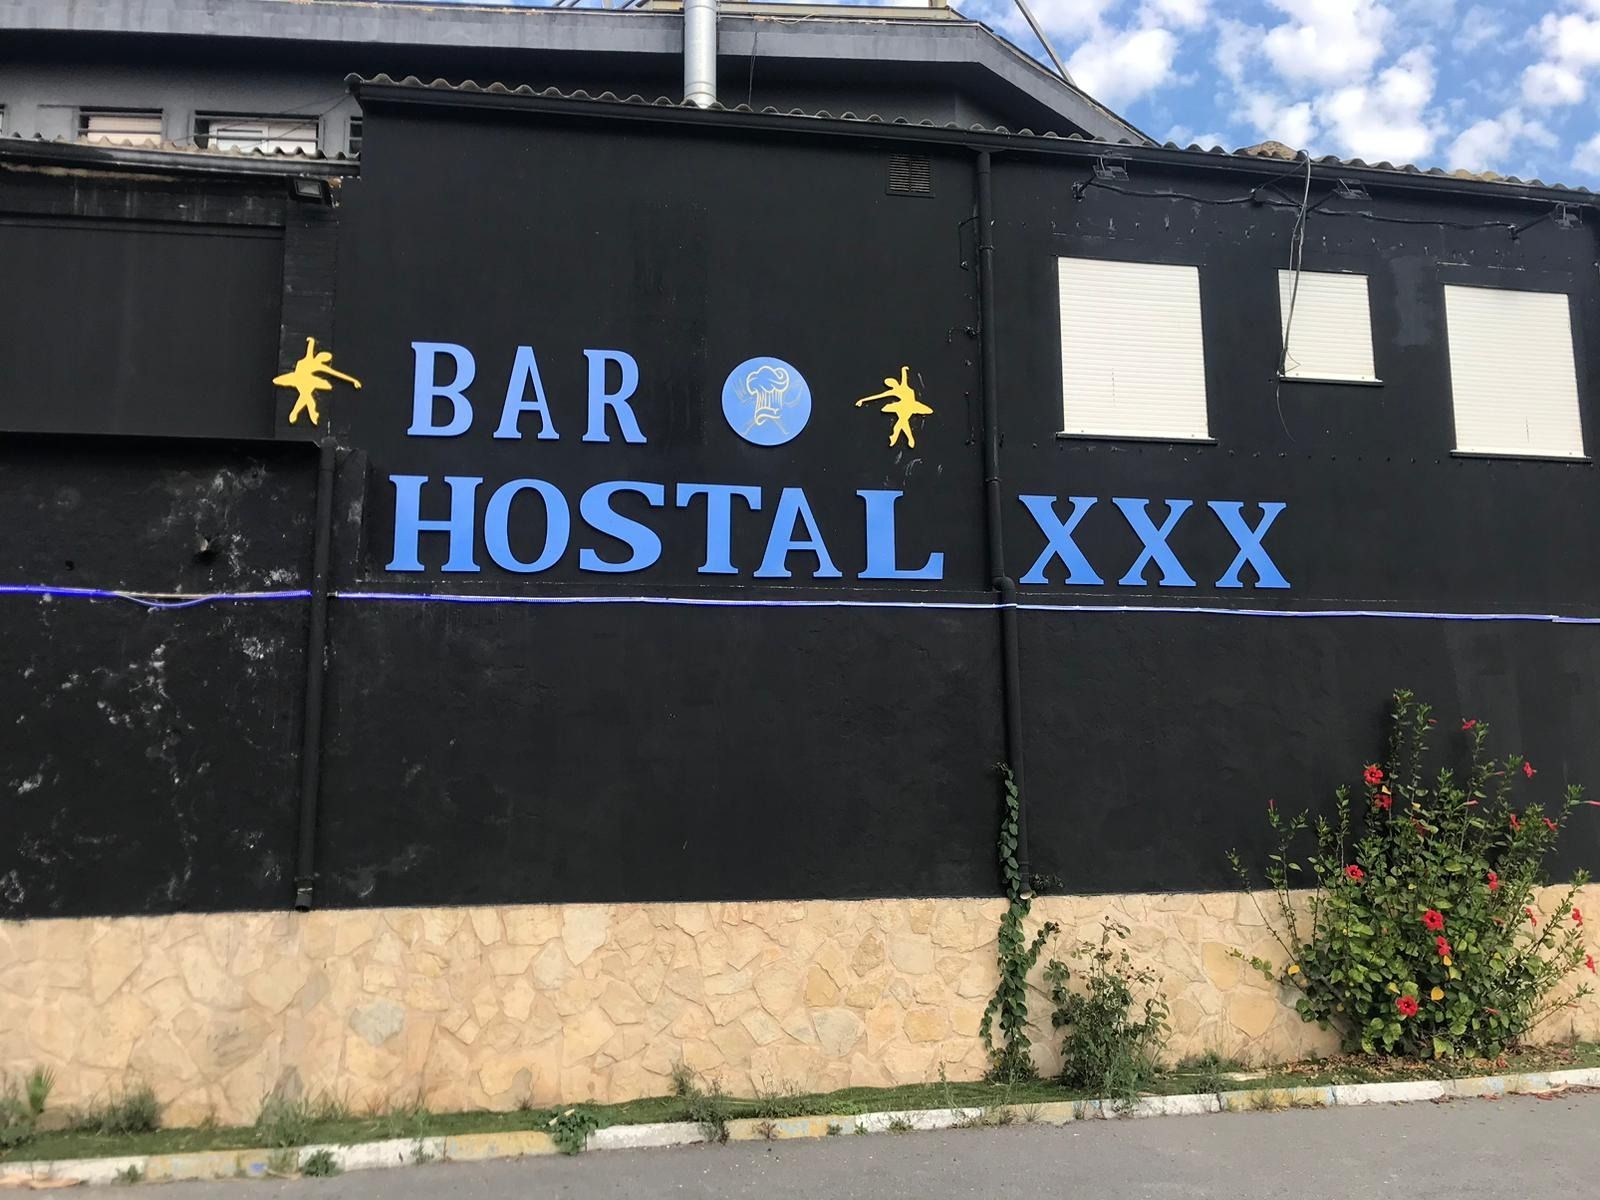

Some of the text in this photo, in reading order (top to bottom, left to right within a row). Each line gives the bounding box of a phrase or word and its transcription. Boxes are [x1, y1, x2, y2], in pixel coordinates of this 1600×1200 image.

[407, 341, 648, 443] BAR
[385, 474, 1292, 589] HOSTAL XXX
